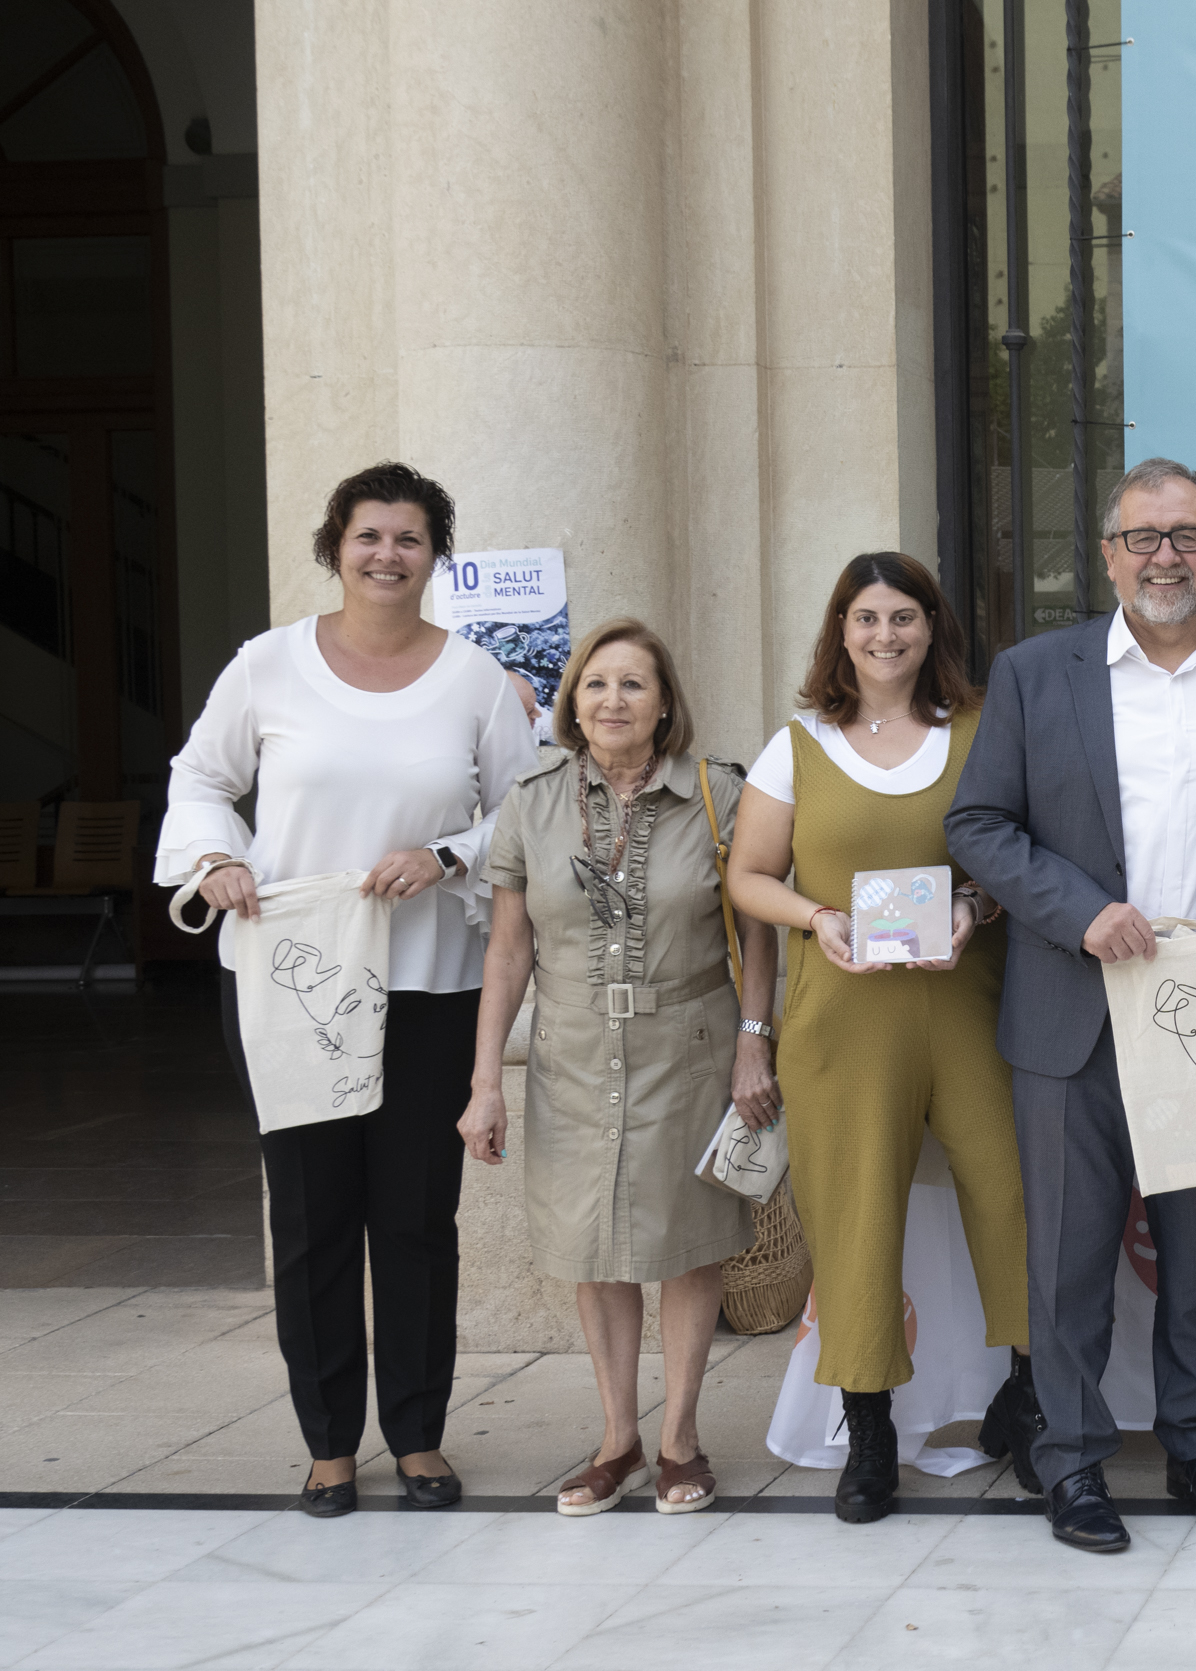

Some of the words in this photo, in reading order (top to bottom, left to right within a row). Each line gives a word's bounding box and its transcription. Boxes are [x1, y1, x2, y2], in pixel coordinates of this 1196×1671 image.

[480, 559, 497, 570] Dia
[499, 557, 542, 568] Mundial
[449, 561, 479, 592] 10
[493, 570, 542, 584] SALUT
[494, 586, 544, 597] MENTAL
[1045, 609, 1073, 620] DEA
[331, 1075, 376, 1108] Salut
